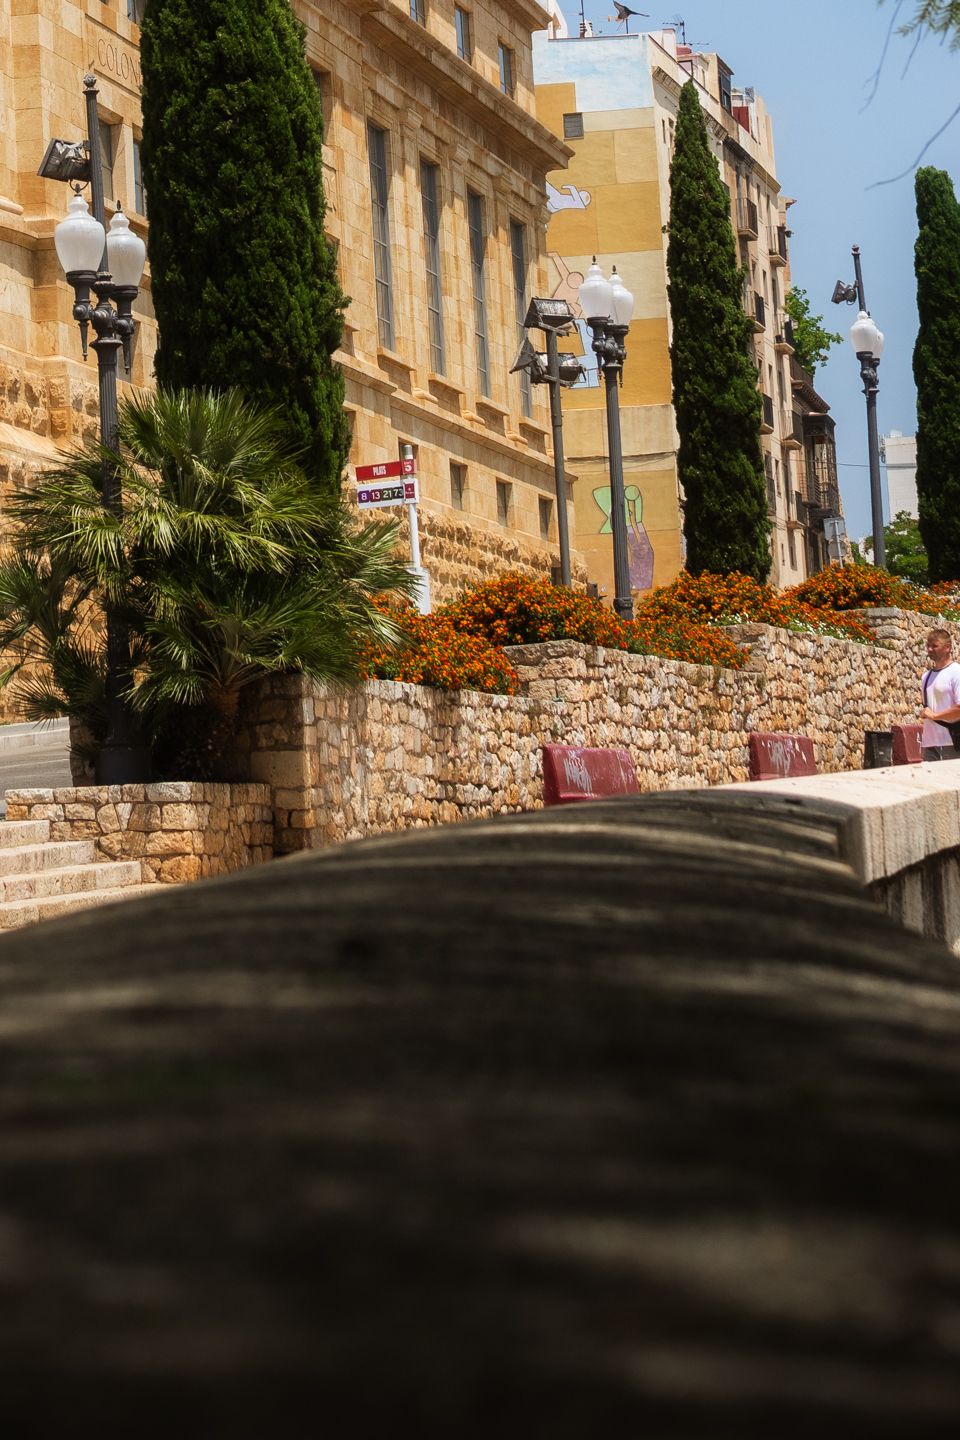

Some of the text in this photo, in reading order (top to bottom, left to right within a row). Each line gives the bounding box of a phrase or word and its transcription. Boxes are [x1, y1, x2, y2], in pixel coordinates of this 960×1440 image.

[361, 492, 368, 500] 8
[371, 491, 381, 500] 13
[382, 490, 392, 498] 21
[393, 488, 404, 497] 73
